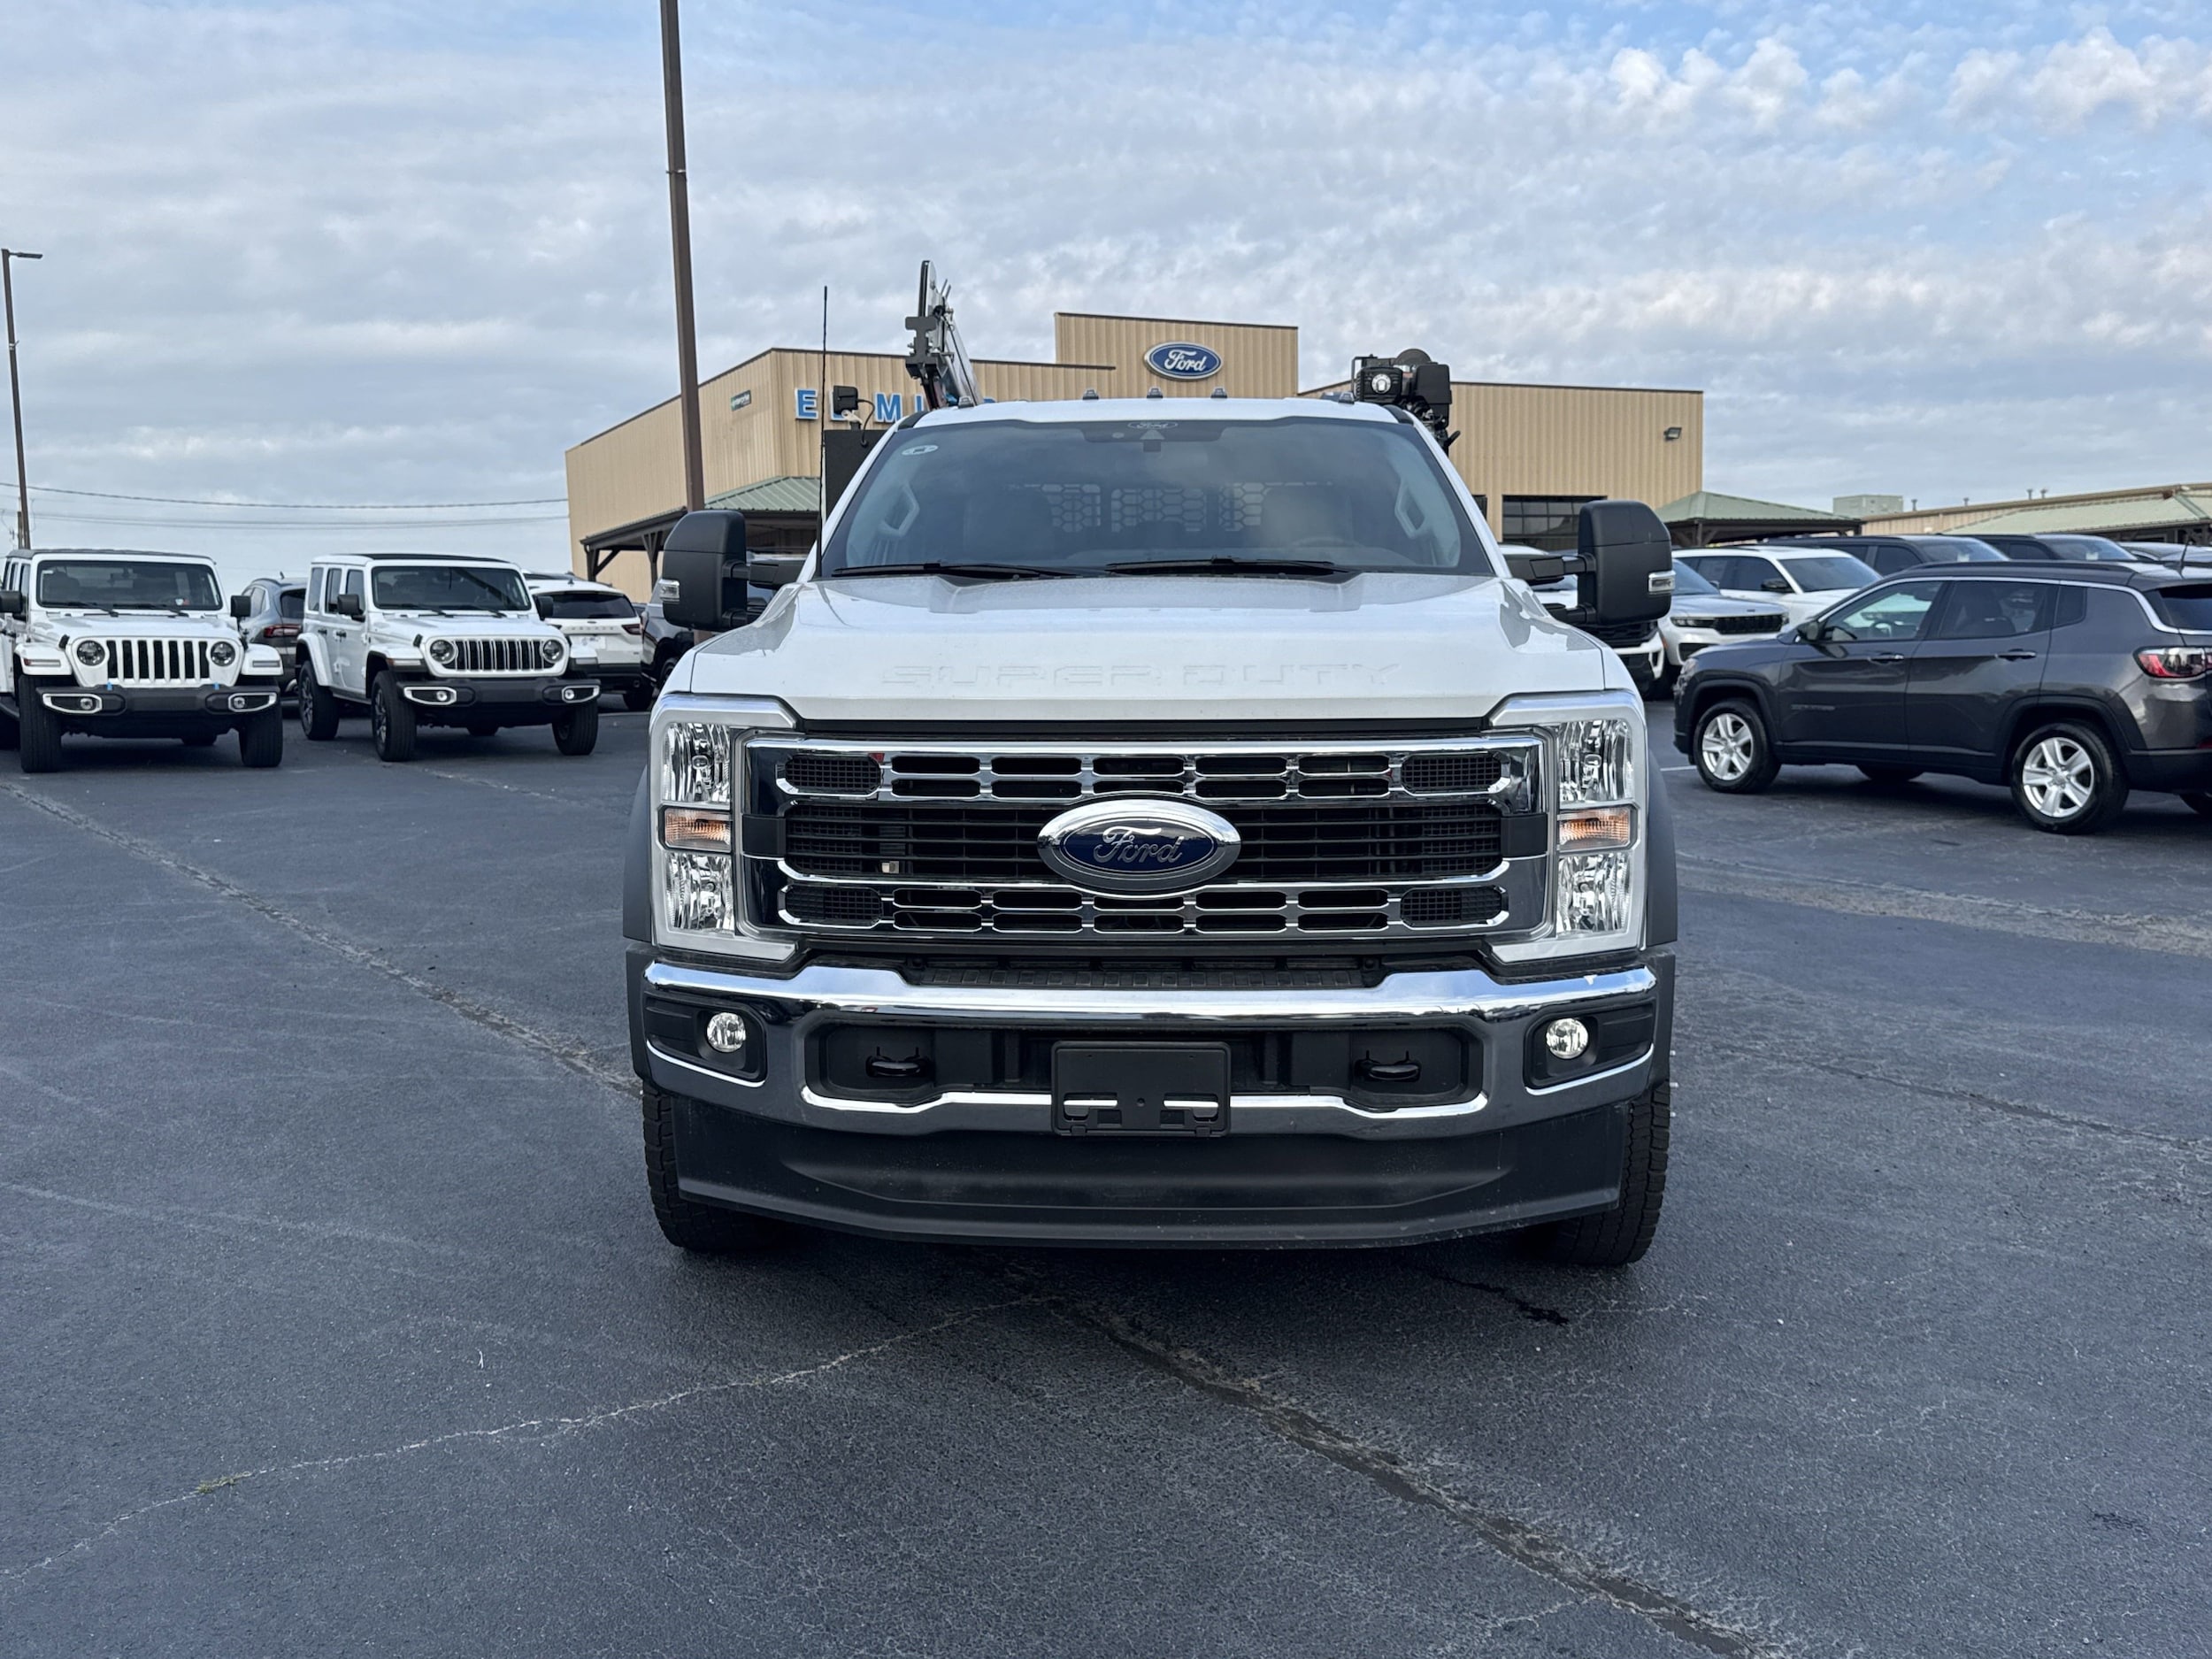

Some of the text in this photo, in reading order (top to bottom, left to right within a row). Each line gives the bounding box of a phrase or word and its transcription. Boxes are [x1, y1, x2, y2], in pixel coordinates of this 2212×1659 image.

[1164, 349, 1207, 372] Ford
[881, 663, 1402, 687] SUPER DUTY
[1093, 826, 1183, 864] Ford
